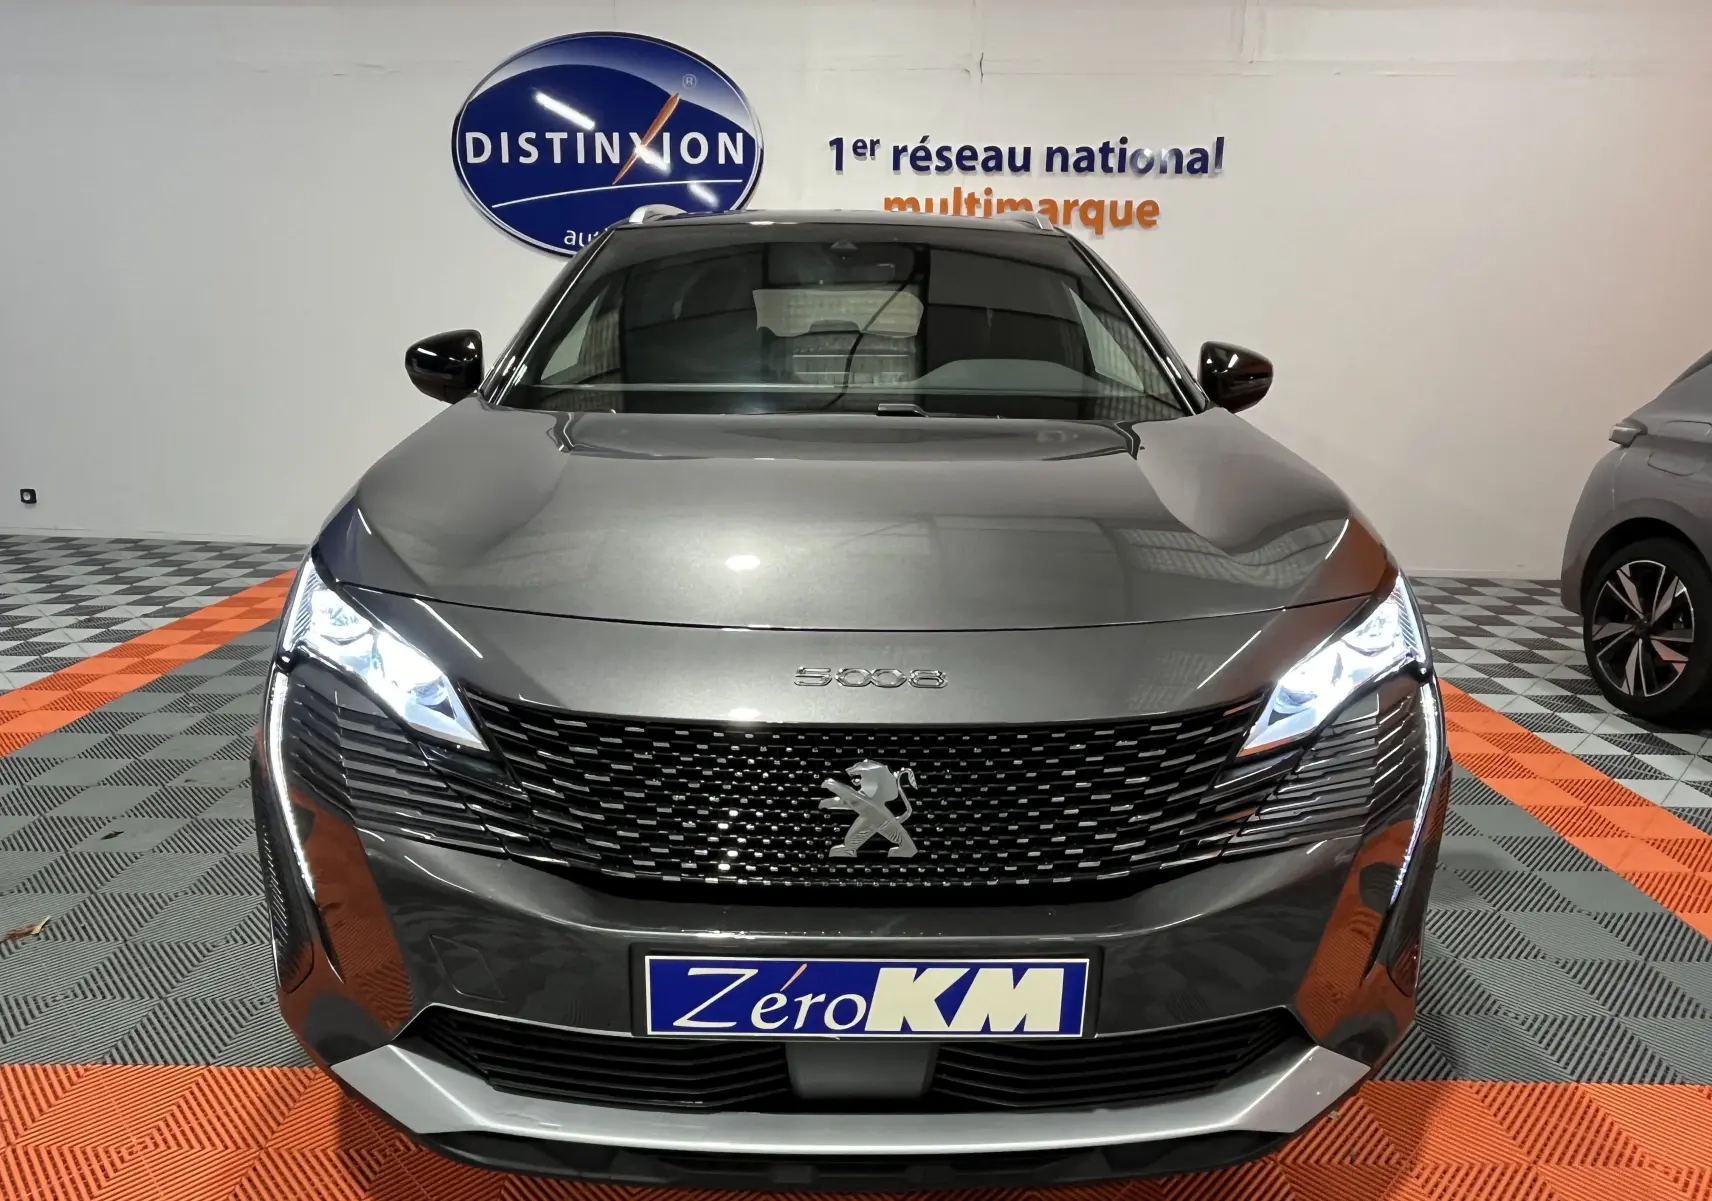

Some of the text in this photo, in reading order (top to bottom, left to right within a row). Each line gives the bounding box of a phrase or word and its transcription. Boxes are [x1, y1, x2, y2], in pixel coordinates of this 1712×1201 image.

[465, 131, 744, 165] DISTINXION
[892, 134, 1032, 174] réseau
[1045, 135, 1226, 175] national
[794, 667, 948, 689] 5008
